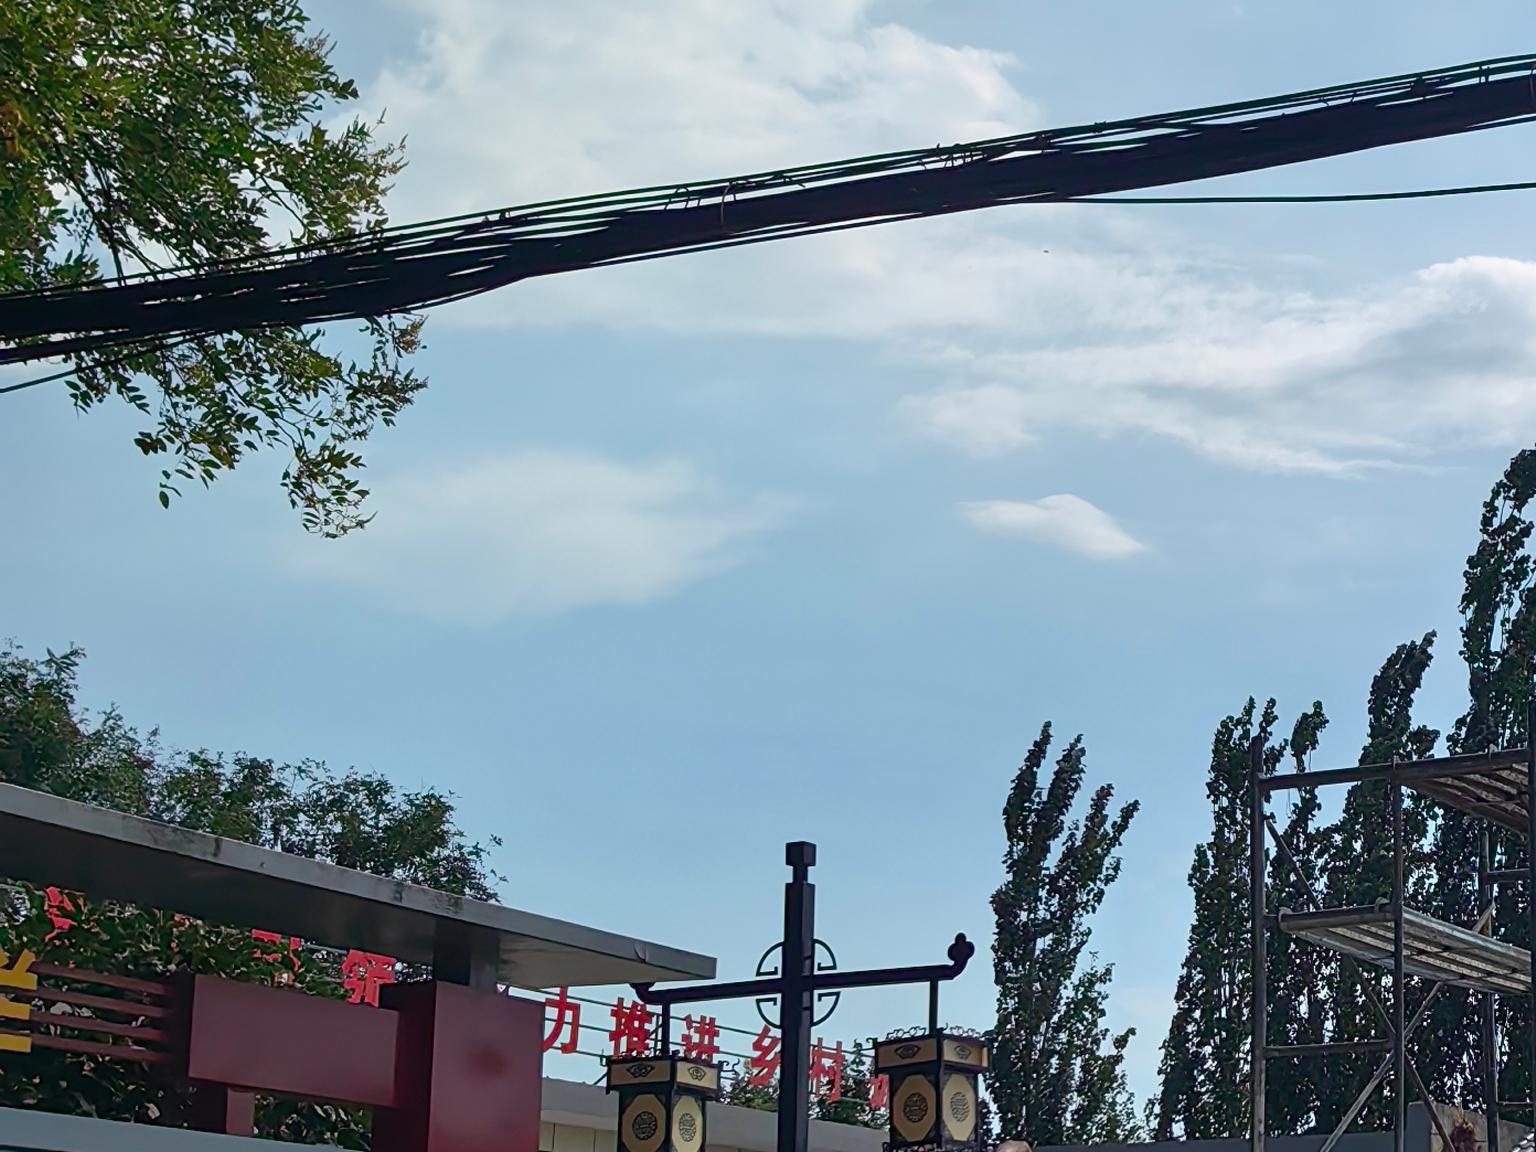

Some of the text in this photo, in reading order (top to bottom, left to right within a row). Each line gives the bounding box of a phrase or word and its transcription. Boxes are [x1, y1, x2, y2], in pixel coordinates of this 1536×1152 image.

[543, 986, 889, 1109] 力推进乡村
